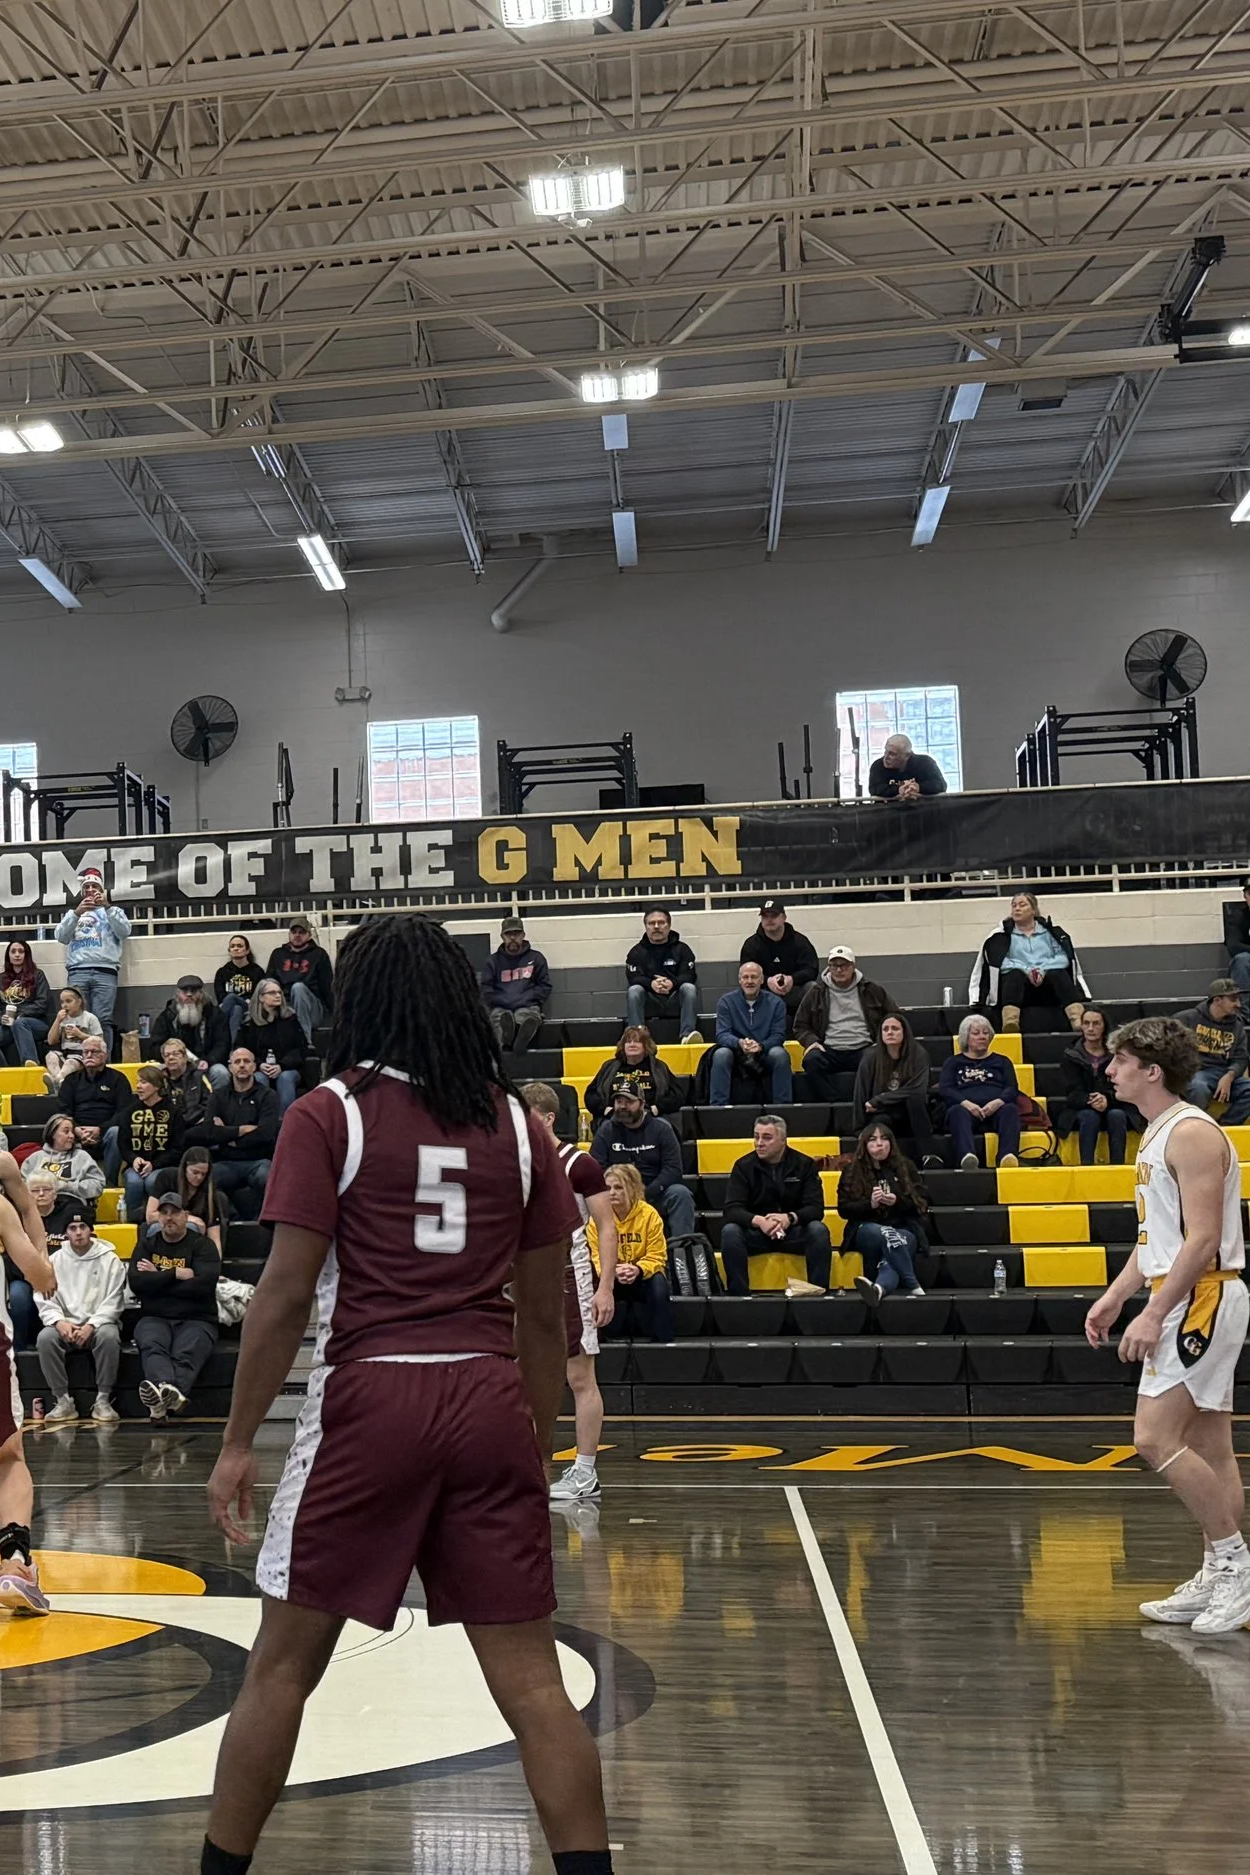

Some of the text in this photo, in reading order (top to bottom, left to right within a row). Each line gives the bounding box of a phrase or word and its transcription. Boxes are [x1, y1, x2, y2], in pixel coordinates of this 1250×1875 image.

[177, 838, 272, 898] OF
[295, 830, 454, 892] THE
[478, 826, 527, 884] G
[552, 816, 741, 881] MEN
[414, 1145, 469, 1255] 5
